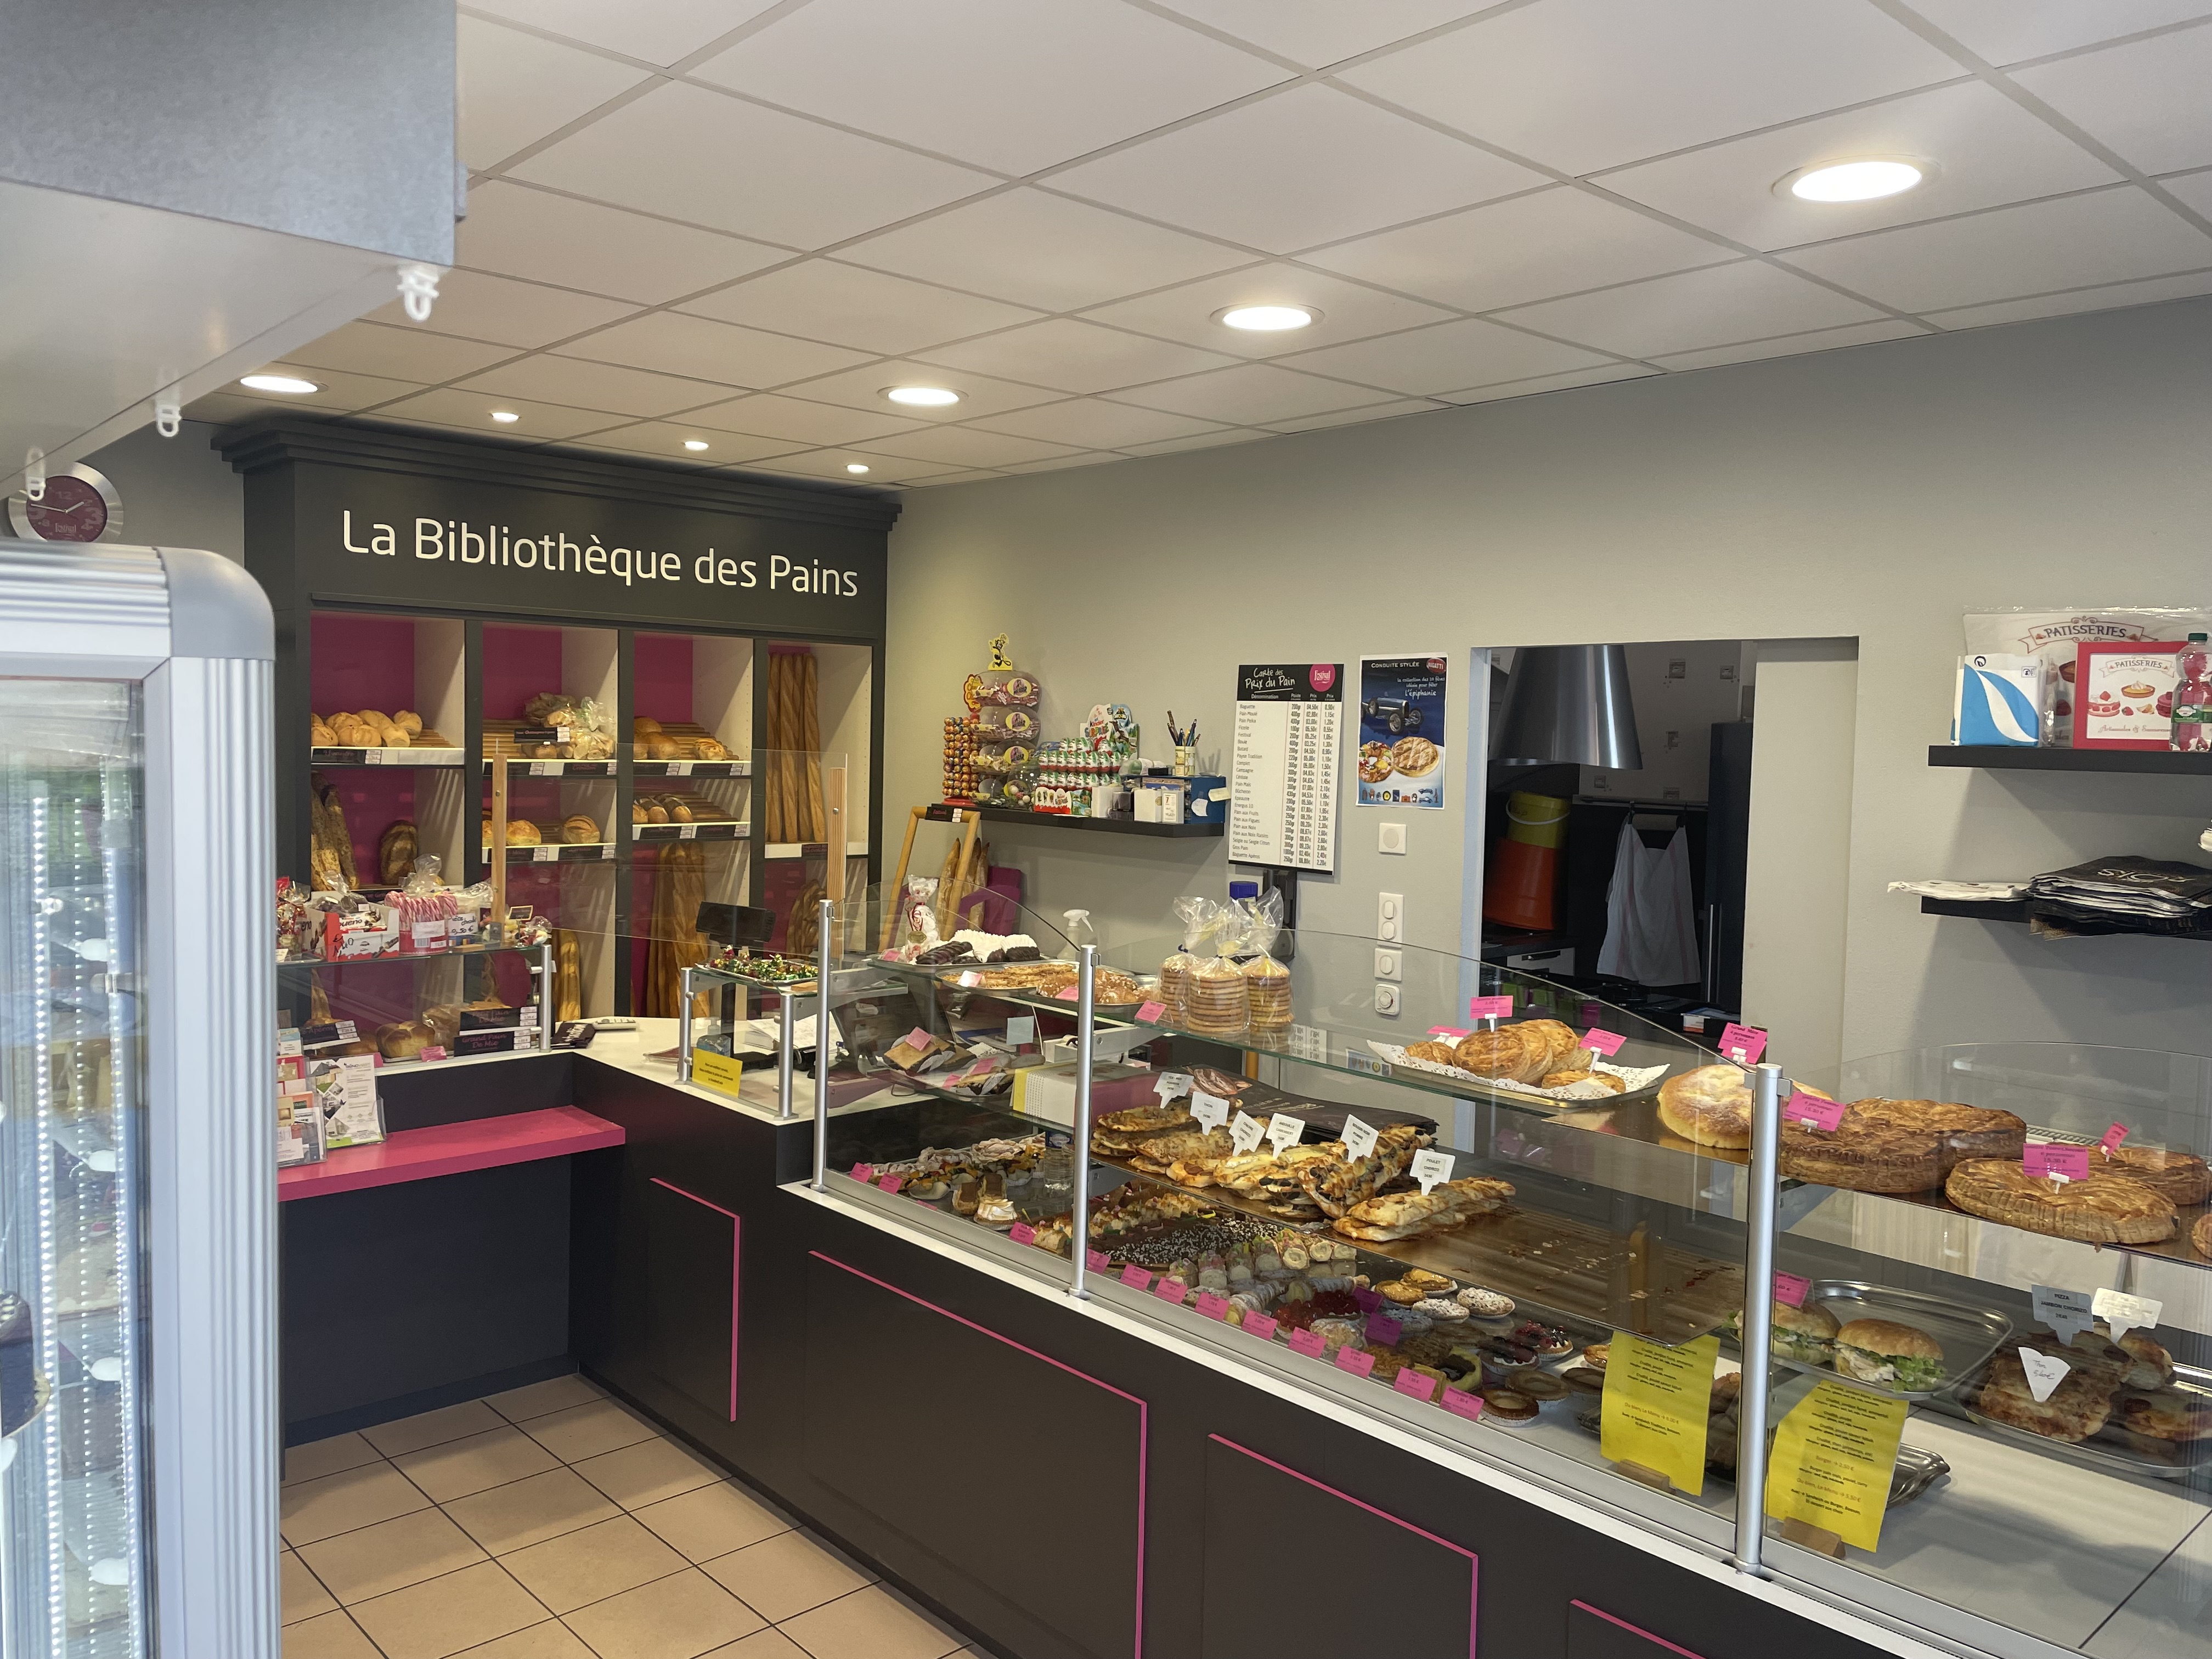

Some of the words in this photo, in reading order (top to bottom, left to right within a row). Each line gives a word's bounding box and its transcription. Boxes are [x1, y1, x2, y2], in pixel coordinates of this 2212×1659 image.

[343, 510, 396, 557] La
[415, 517, 681, 587] Bibliothèque
[695, 547, 757, 588] des
[770, 555, 859, 597] Pains
[2044, 625, 2127, 639] PATISSERIES
[2114, 660, 2162, 669] PATISSERIES
[1254, 668, 1273, 678] Carte
[1245, 678, 1263, 690] Prix
[1266, 677, 1275, 687] du
[1278, 675, 1295, 686] Pain
[2041, 1300, 2062, 1309] JAMBON
[2063, 1305, 2087, 1313] CHORIZO
